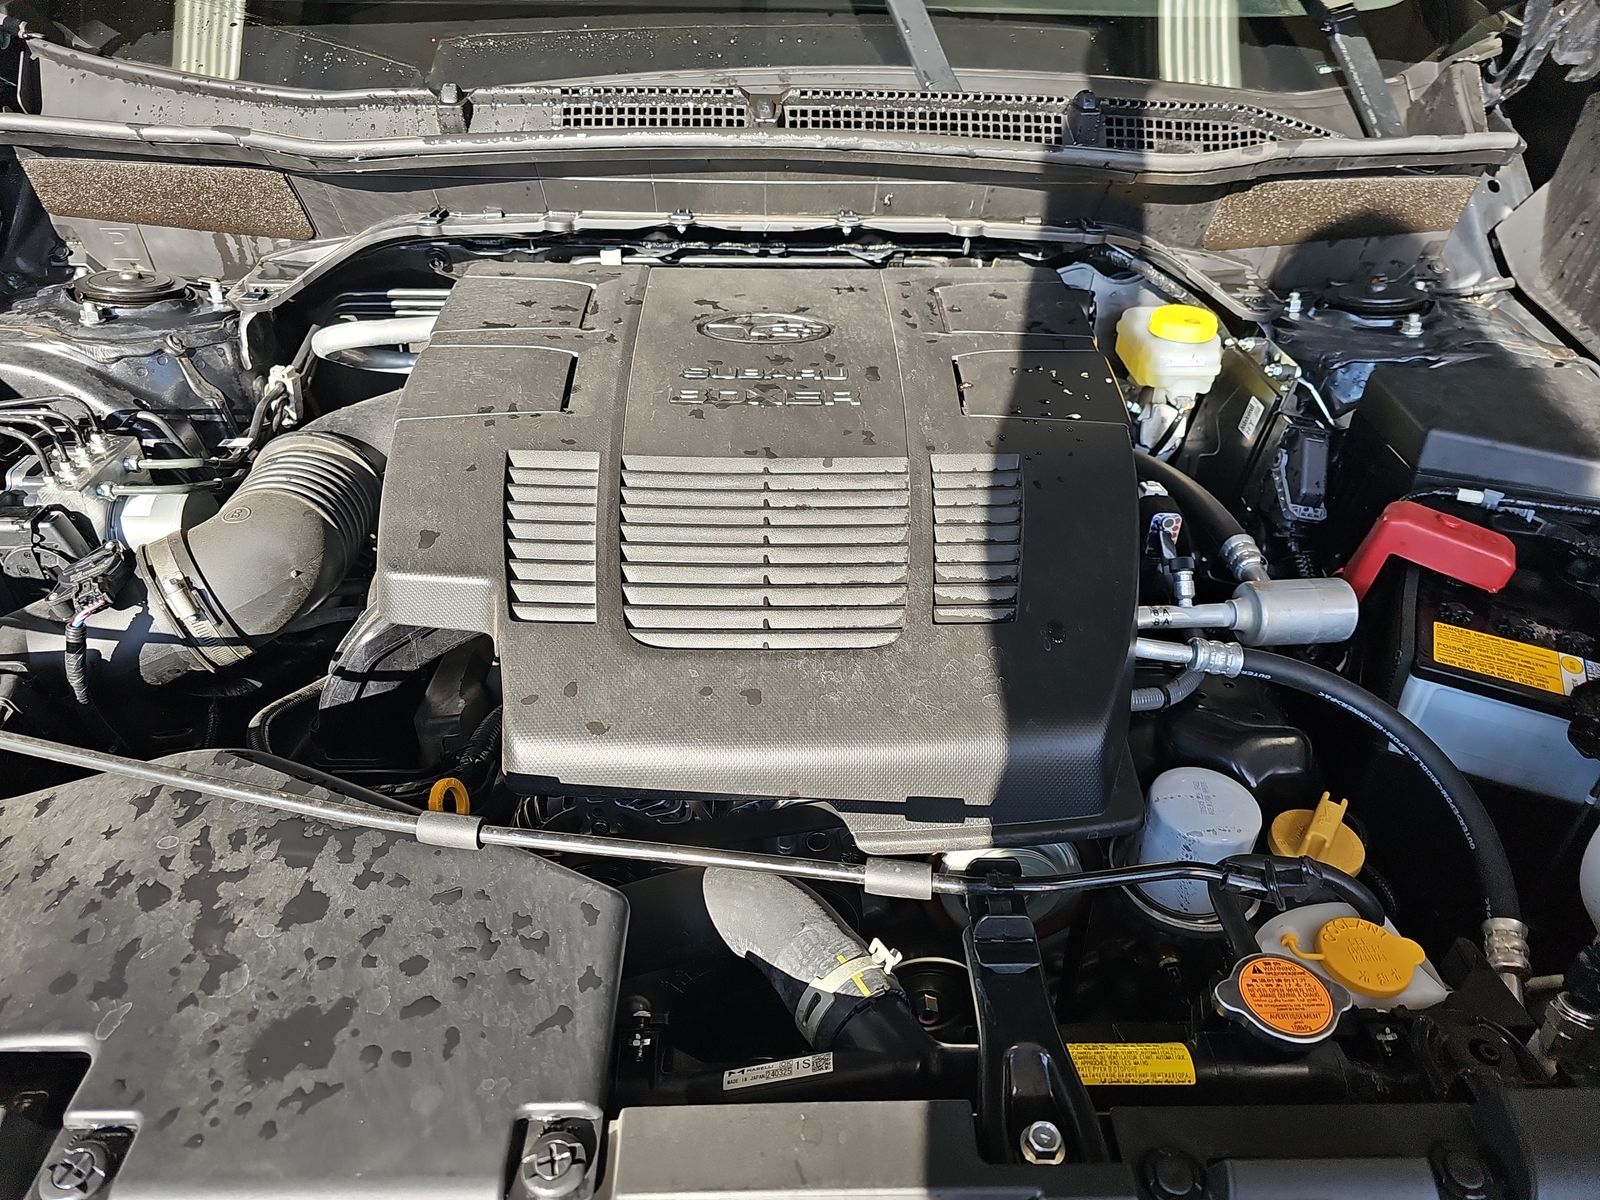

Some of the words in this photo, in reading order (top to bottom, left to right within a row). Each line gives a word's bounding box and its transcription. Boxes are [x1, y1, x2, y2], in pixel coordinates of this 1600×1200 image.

[680, 367, 849, 380] SUBARU
[669, 388, 861, 406] BOXER
[1436, 624, 1471, 635] DANGER
[1436, 642, 1471, 654] POISON
[1322, 919, 1387, 942] COOLANT
[746, 1064, 774, 1072] MARELLI
